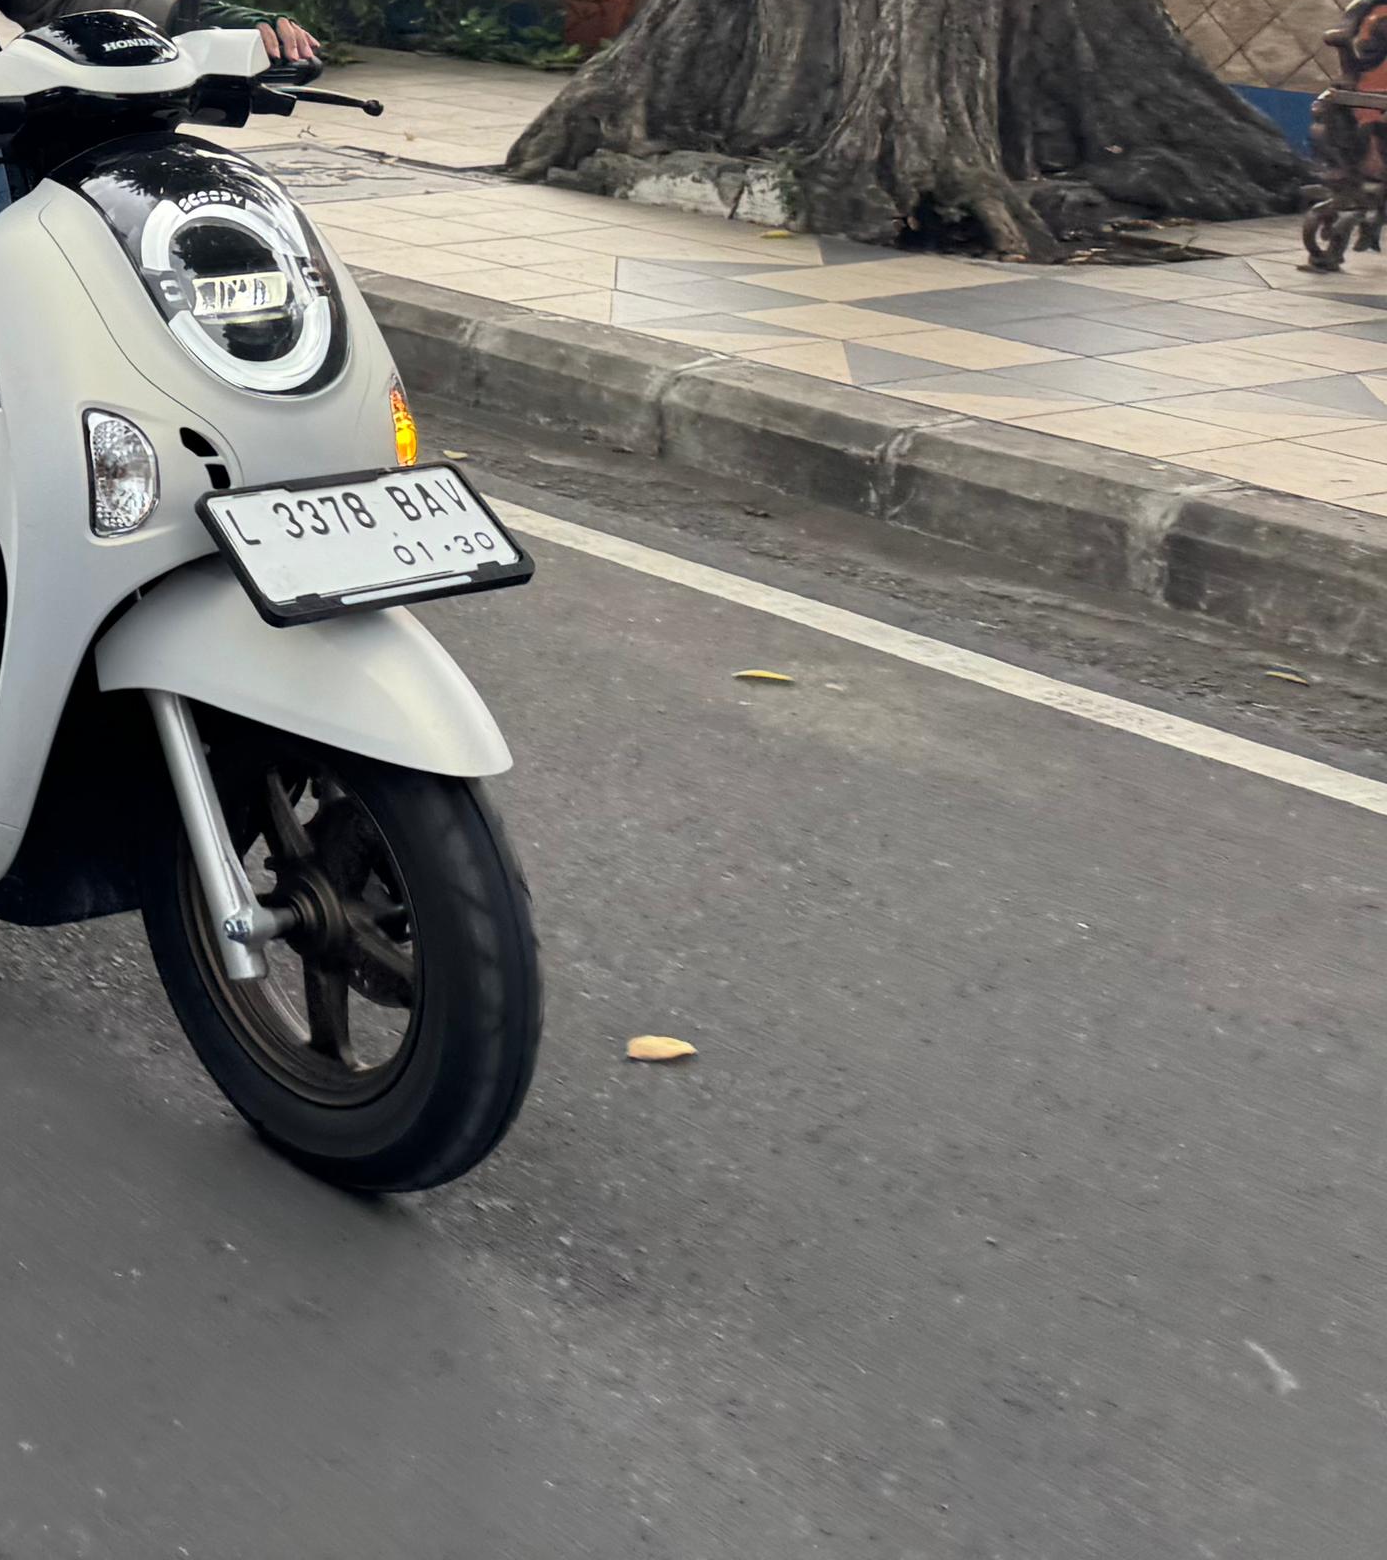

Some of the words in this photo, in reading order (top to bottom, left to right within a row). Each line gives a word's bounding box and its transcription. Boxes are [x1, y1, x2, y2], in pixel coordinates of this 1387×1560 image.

[102, 37, 163, 52] HONDA
[178, 190, 244, 212] SCOOPY
[225, 509, 263, 546] L
[272, 491, 377, 539] 3378
[384, 478, 467, 522] BAV
